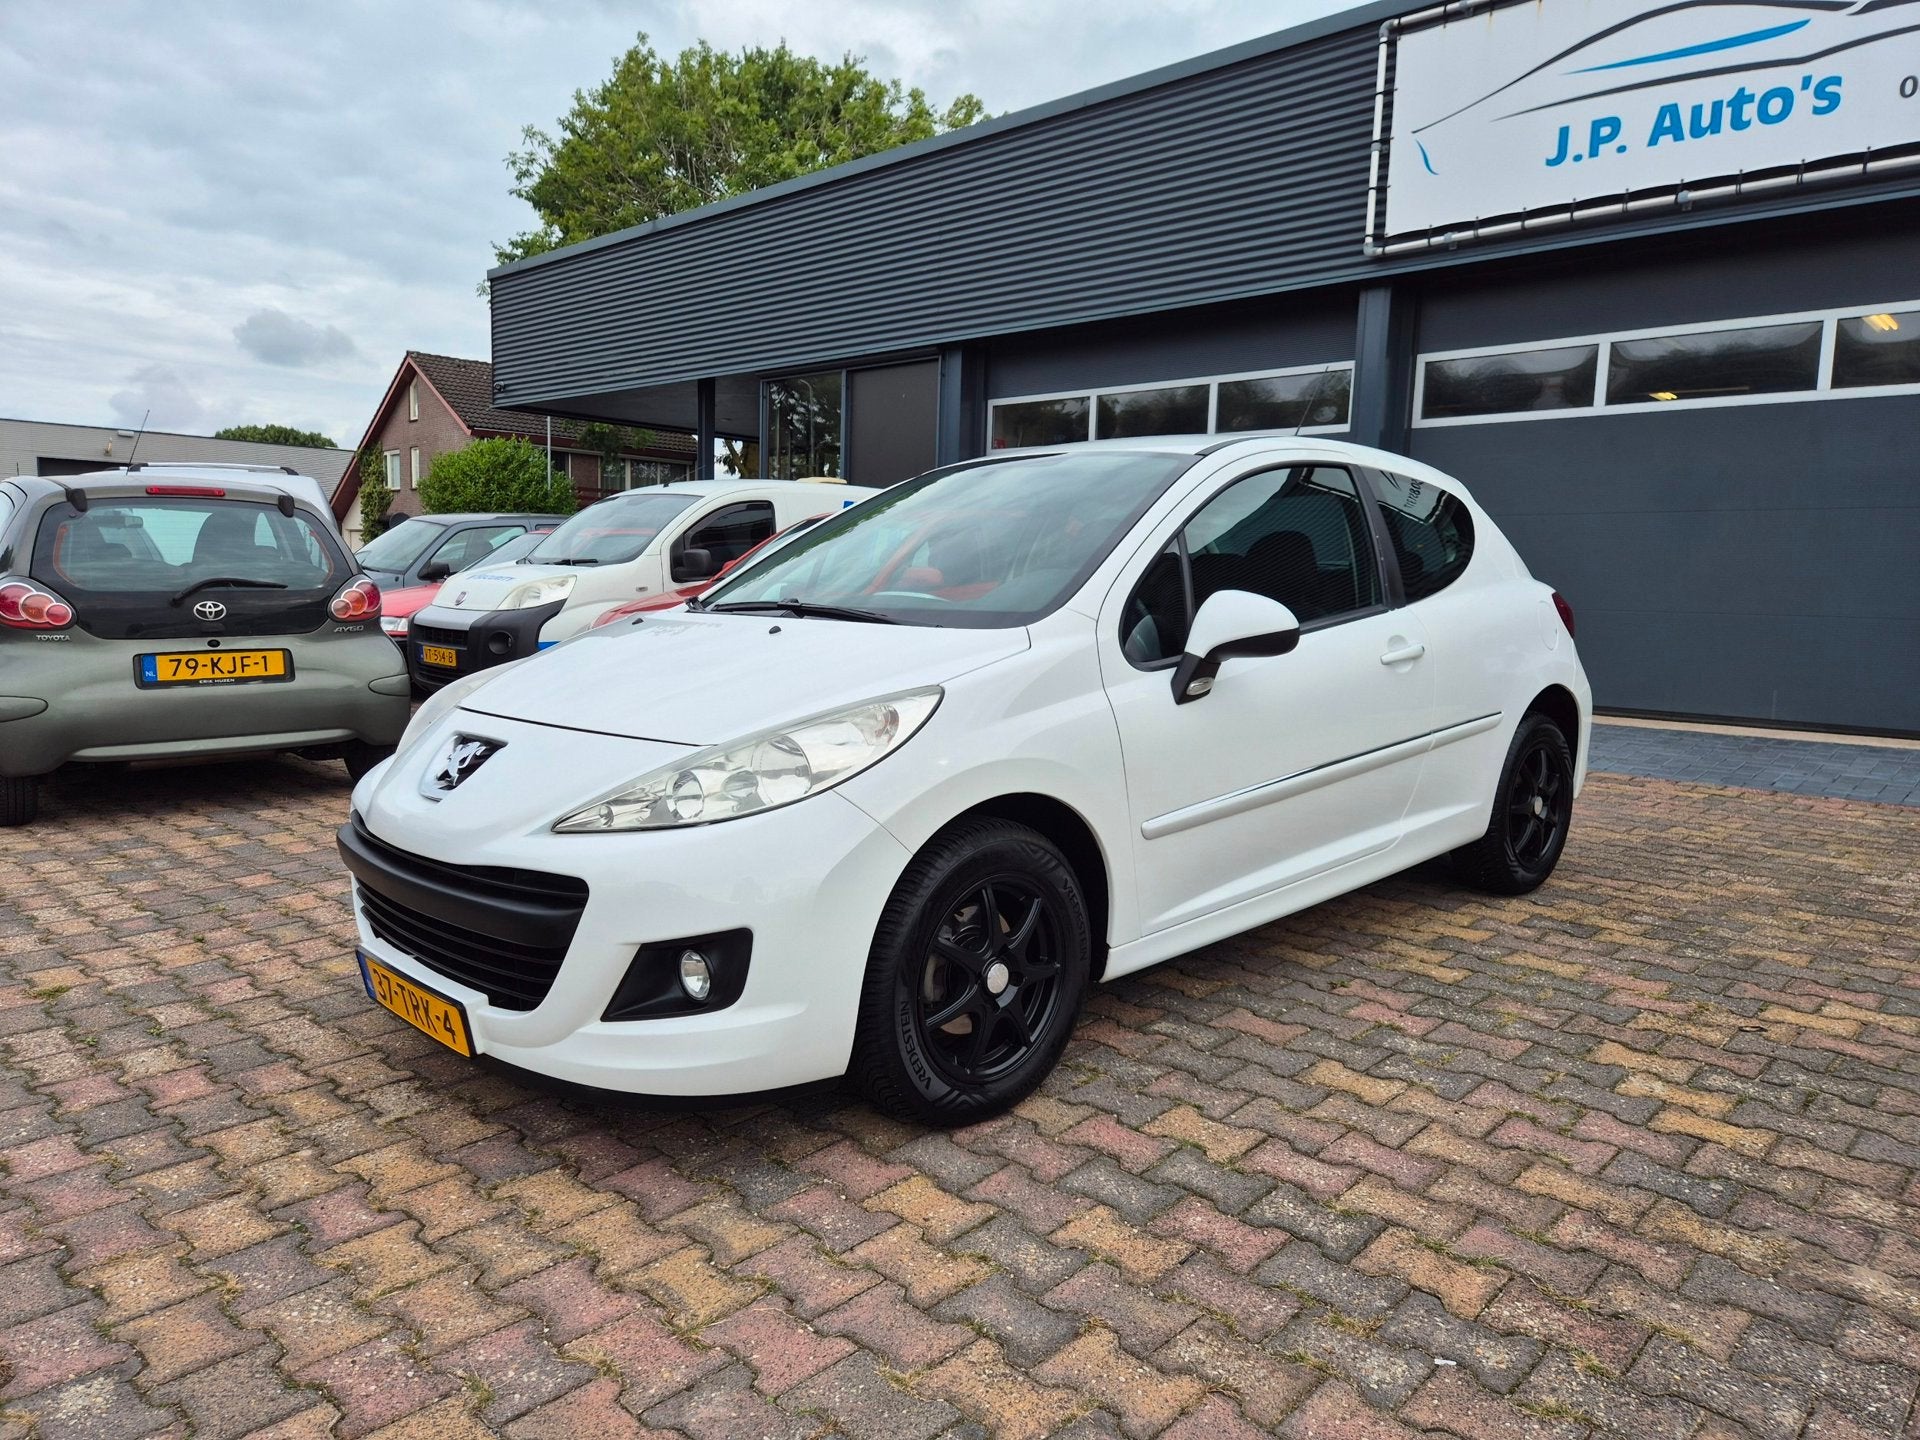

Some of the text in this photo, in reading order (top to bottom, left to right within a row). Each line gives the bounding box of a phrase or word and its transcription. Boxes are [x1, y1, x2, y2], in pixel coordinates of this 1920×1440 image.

[1545, 74, 1843, 167] J.P. Auto's
[168, 655, 268, 677] 79-KJF-1
[373, 967, 457, 1044] 37-TRK-4
[900, 1000, 932, 1090] VREDESTEIN
